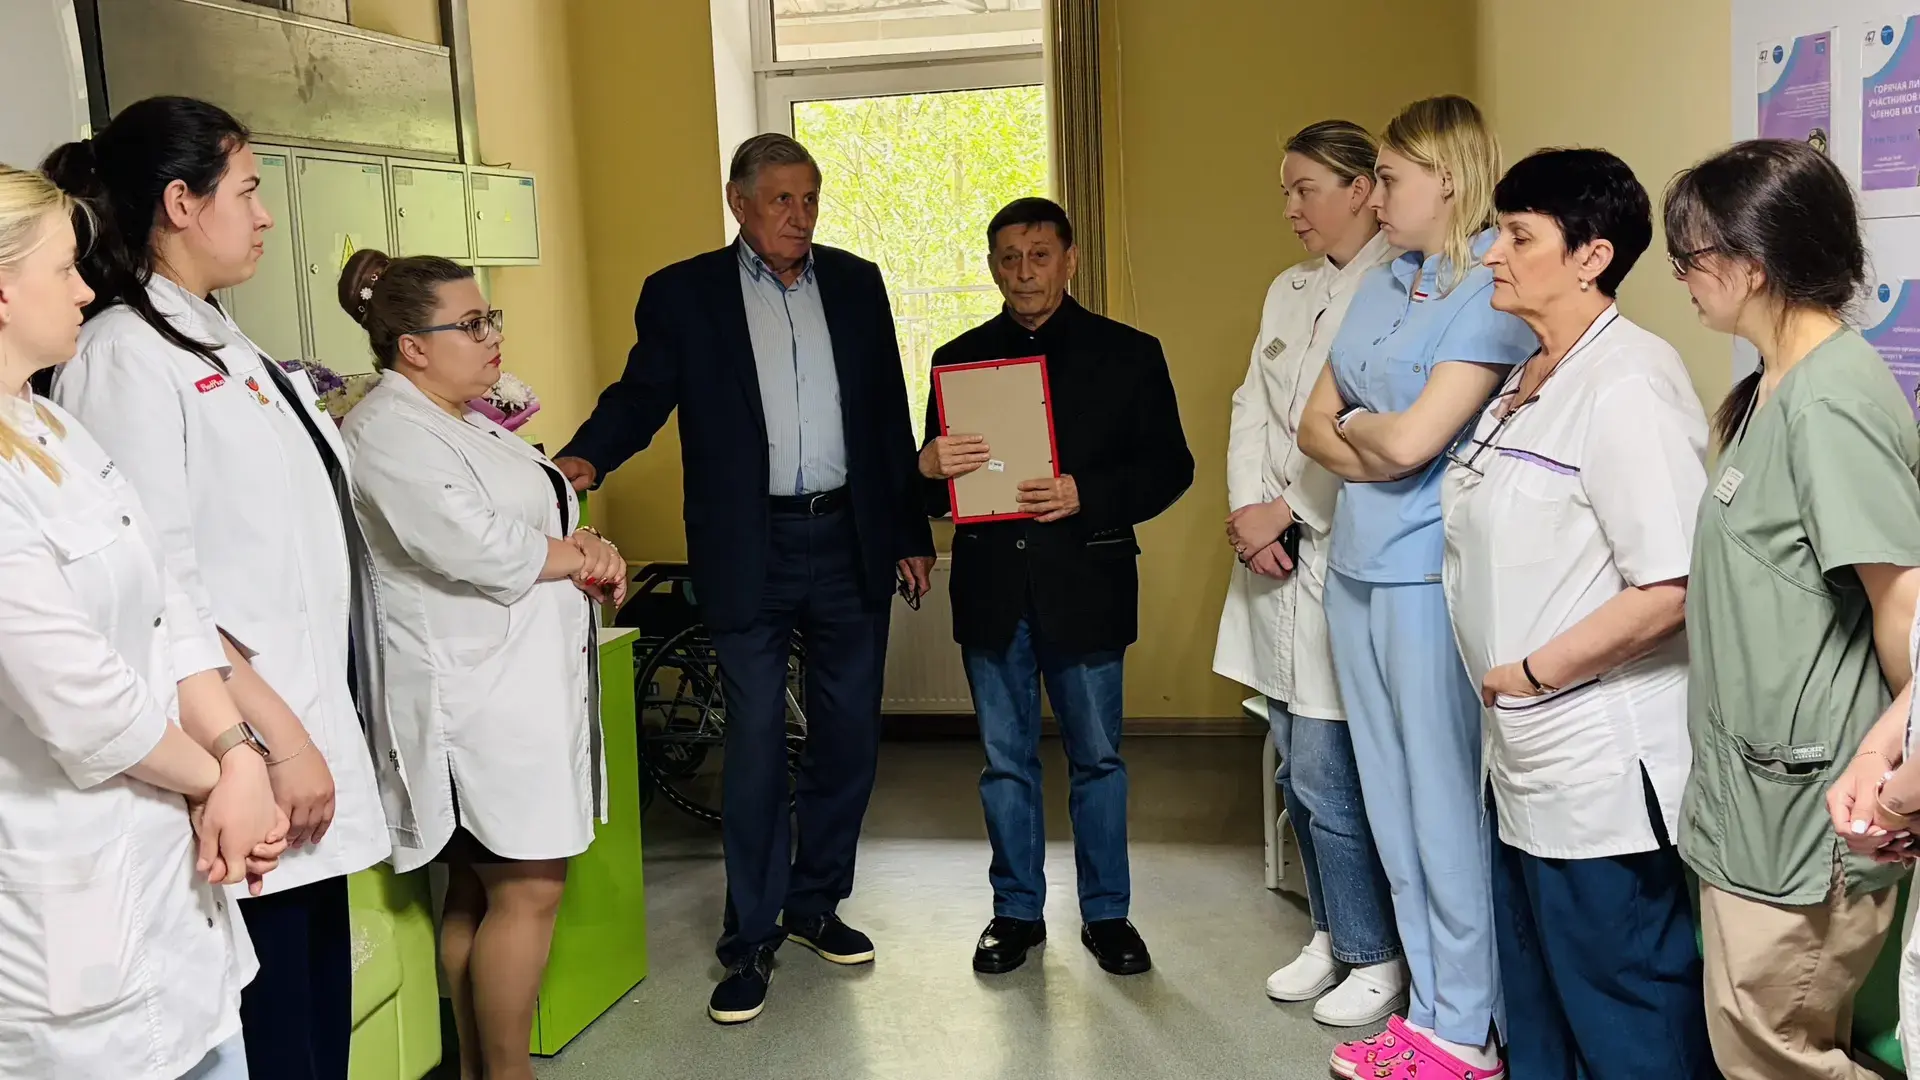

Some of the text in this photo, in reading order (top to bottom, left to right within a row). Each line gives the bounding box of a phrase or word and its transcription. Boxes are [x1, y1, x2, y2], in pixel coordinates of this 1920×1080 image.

[1874, 81, 1907, 94] ГОРЯЧАЯ
[1868, 92, 1917, 107] УЧАСТНИКОВ
[1870, 107, 1900, 119] ЧЛЕНОВ
[1901, 106, 1912, 116] ИХ
